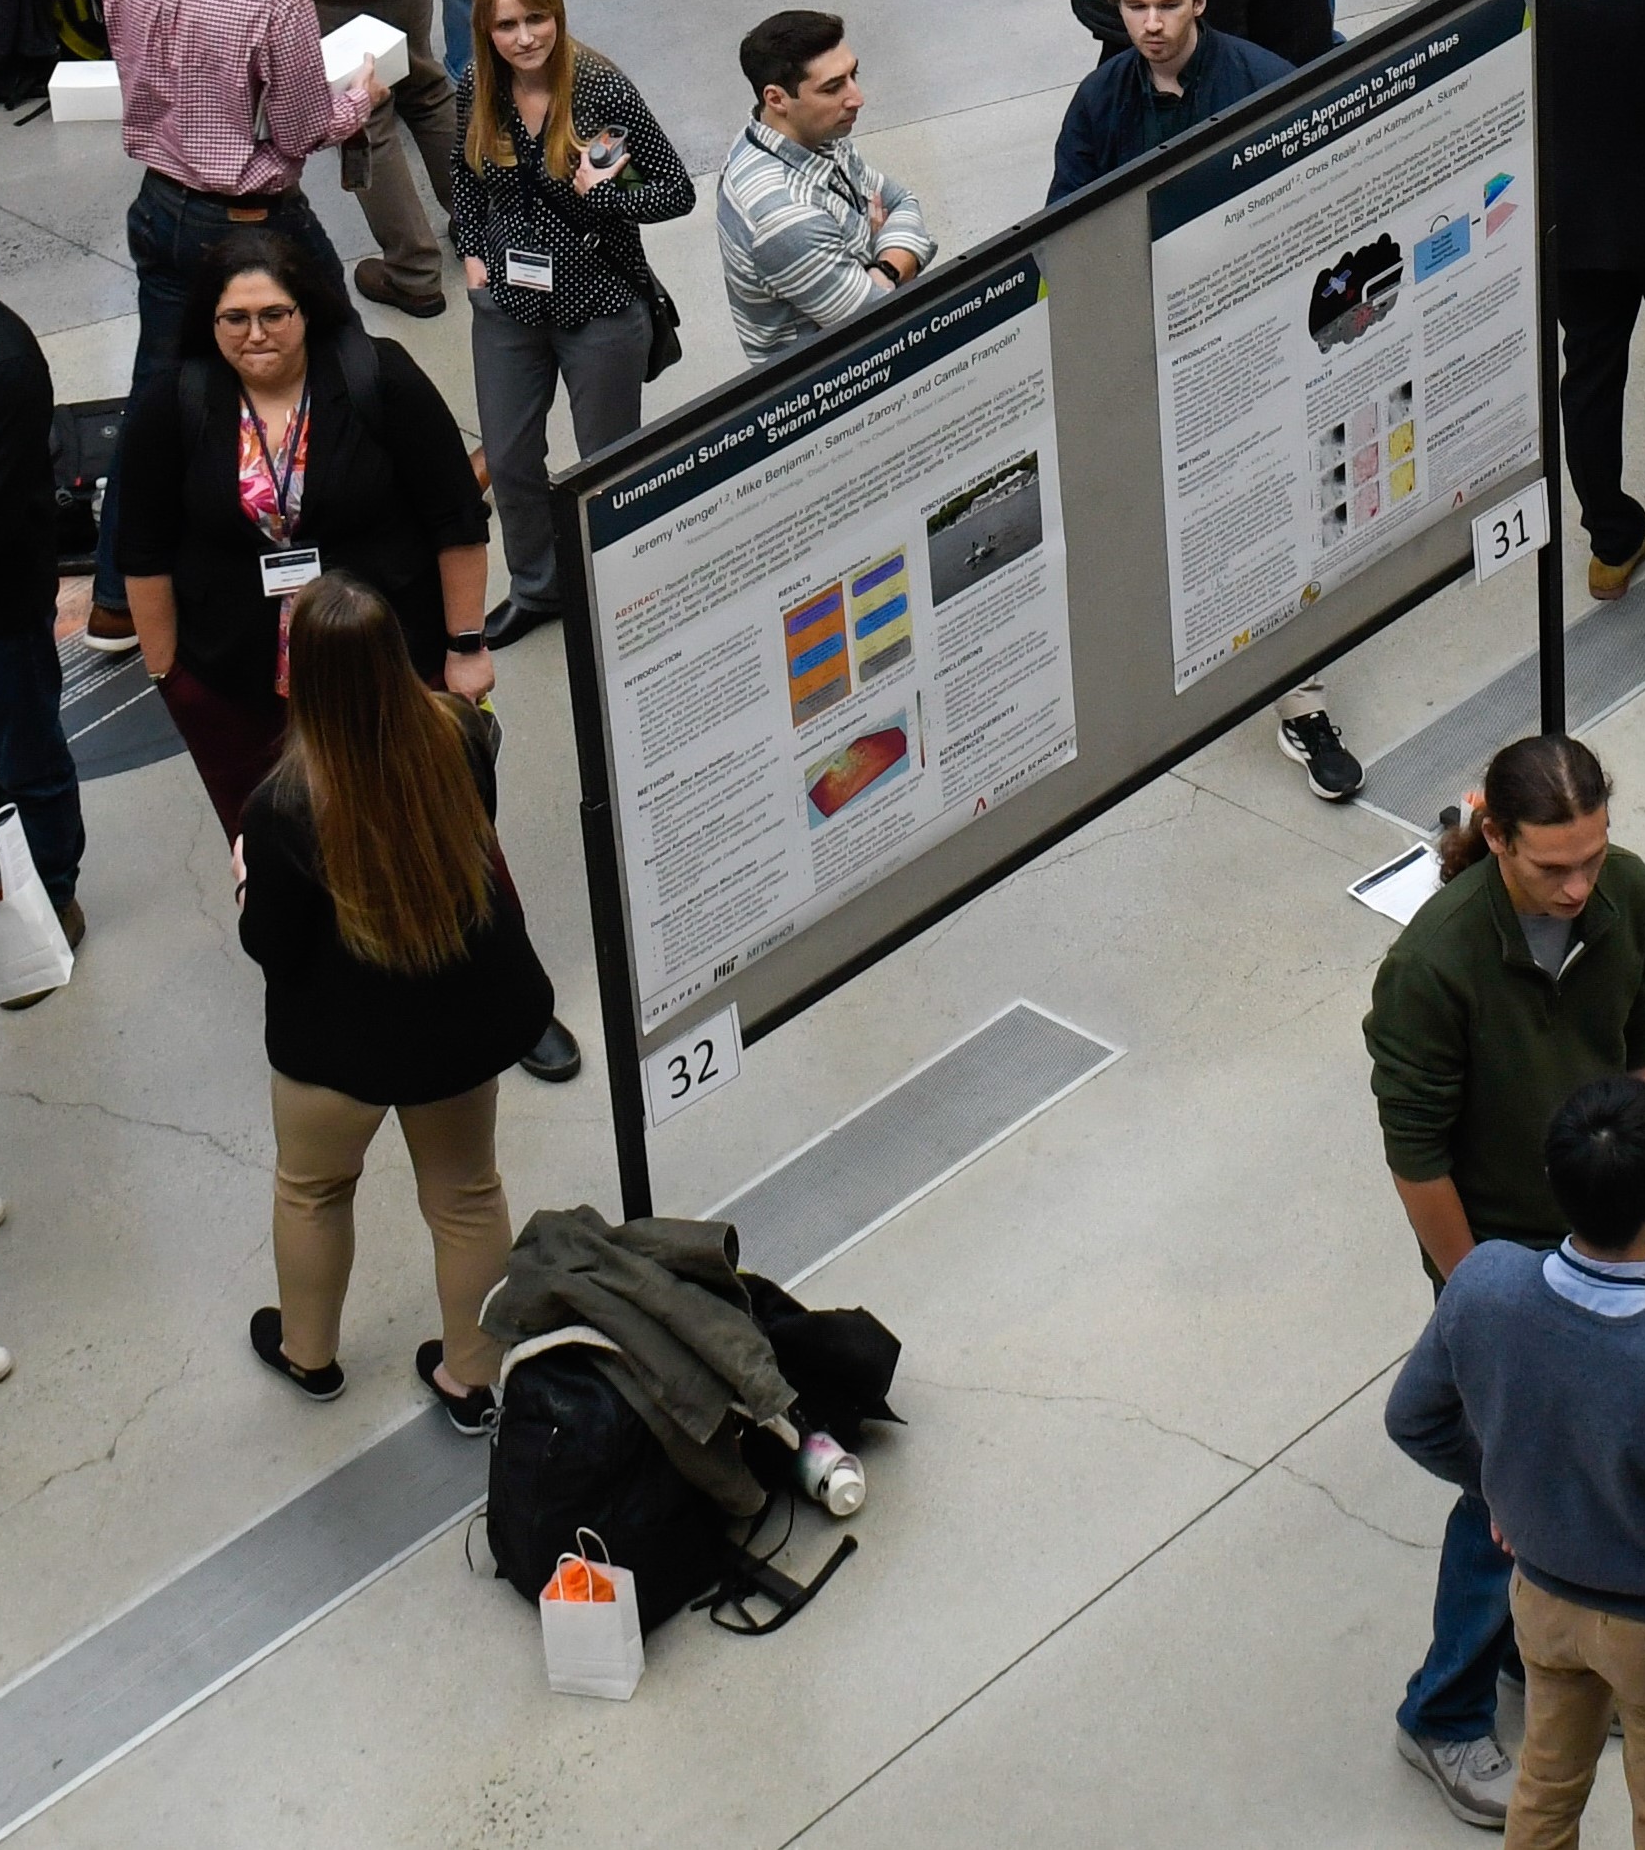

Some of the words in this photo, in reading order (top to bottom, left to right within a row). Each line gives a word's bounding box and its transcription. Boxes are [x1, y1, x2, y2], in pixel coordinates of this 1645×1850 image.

[1232, 151, 1241, 170] A
[1245, 114, 1308, 163] Stochastic
[1312, 80, 1368, 126] Approach
[1371, 72, 1383, 91] to
[1386, 48, 1425, 83] Terrain
[1428, 29, 1458, 59] Maps
[1282, 136, 1298, 160] for
[1302, 120, 1328, 148] Safe
[1332, 99, 1365, 131] Lunar
[1369, 71, 1415, 112] Landing
[1224, 203, 1245, 228] Anja
[1305, 157, 1327, 181] Chris
[1365, 127, 1381, 146] and
[1383, 102, 1424, 135] Katherine
[1422, 291, 1457, 319] DISCUSSION
[1172, 333, 1221, 369] INTRODUCTION
[612, 451, 694, 513] Unmanned
[698, 418, 754, 465] Surface
[758, 386, 809, 432] Vehicle
[814, 333, 905, 403] Development
[909, 321, 927, 348] for
[931, 291, 980, 335] Comms
[985, 266, 1024, 304] Aware
[1305, 367, 1332, 391] RESULTS
[767, 403, 815, 445] Swarm
[820, 361, 890, 418] Autonomy
[632, 524, 672, 561] Jeremy
[736, 474, 761, 501] Mike
[825, 416, 863, 450] Samuel
[912, 378, 931, 401] and
[934, 357, 968, 388] Camila
[1177, 446, 1210, 473] METHODS
[920, 485, 961, 515] DISCUSSION
[968, 447, 1025, 487] DEMONSTRATION
[1493, 508, 1531, 560] 31
[778, 573, 810, 599] RESULTS
[1250, 605, 1295, 640] MICHIGAN
[624, 649, 681, 689] INTRODUCTION
[934, 645, 982, 681] CONCLUSIONS
[1183, 646, 1225, 680] DRAPER
[939, 705, 1013, 758] ACKNOWLEDGEMENTS
[939, 734, 984, 767] REFERENCES
[637, 770, 674, 798] METHODS
[993, 765, 1026, 793] DRAPER
[1028, 737, 1067, 771] SCHOLARS
[652, 980, 700, 1015] DRAPER
[667, 1039, 719, 1100] 32
